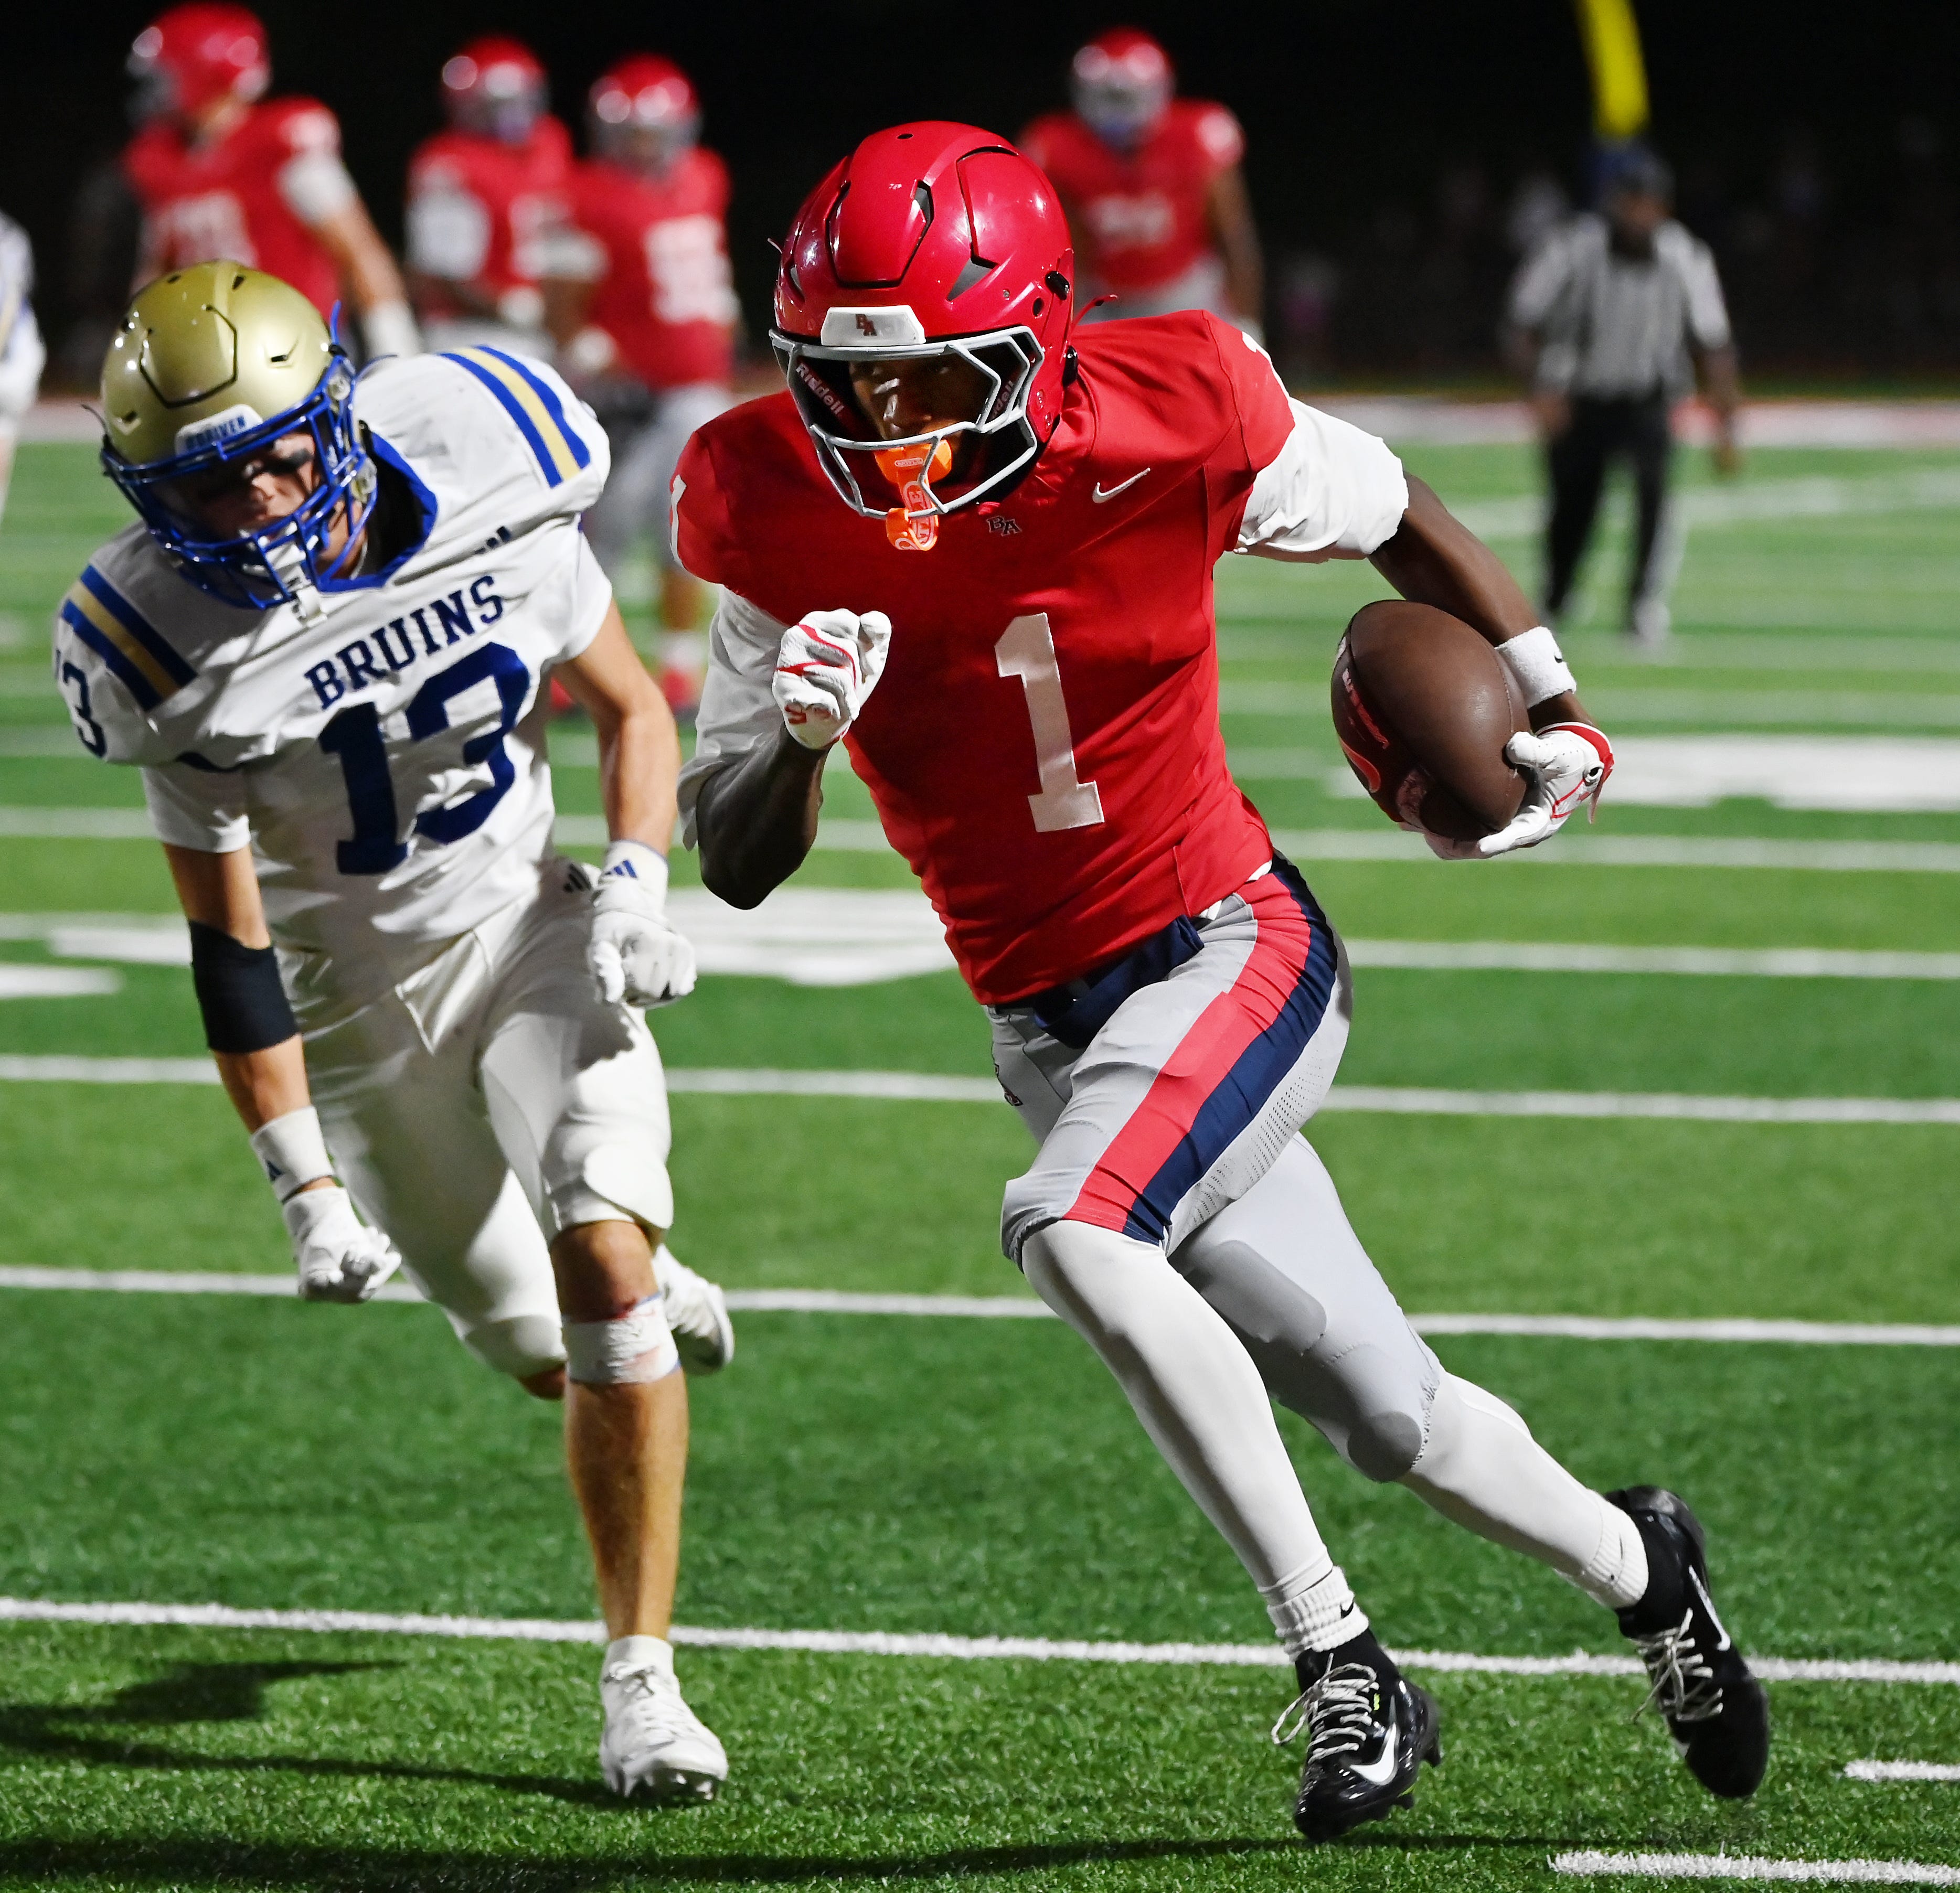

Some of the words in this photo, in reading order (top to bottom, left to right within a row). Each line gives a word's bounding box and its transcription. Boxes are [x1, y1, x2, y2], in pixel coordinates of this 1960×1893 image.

[855, 314, 877, 336] BA
[796, 362, 844, 415] Riddell
[986, 515, 1022, 537] BA
[304, 575, 504, 711] BRUINS
[319, 641, 530, 875] 13
[995, 612, 1105, 833] 1
